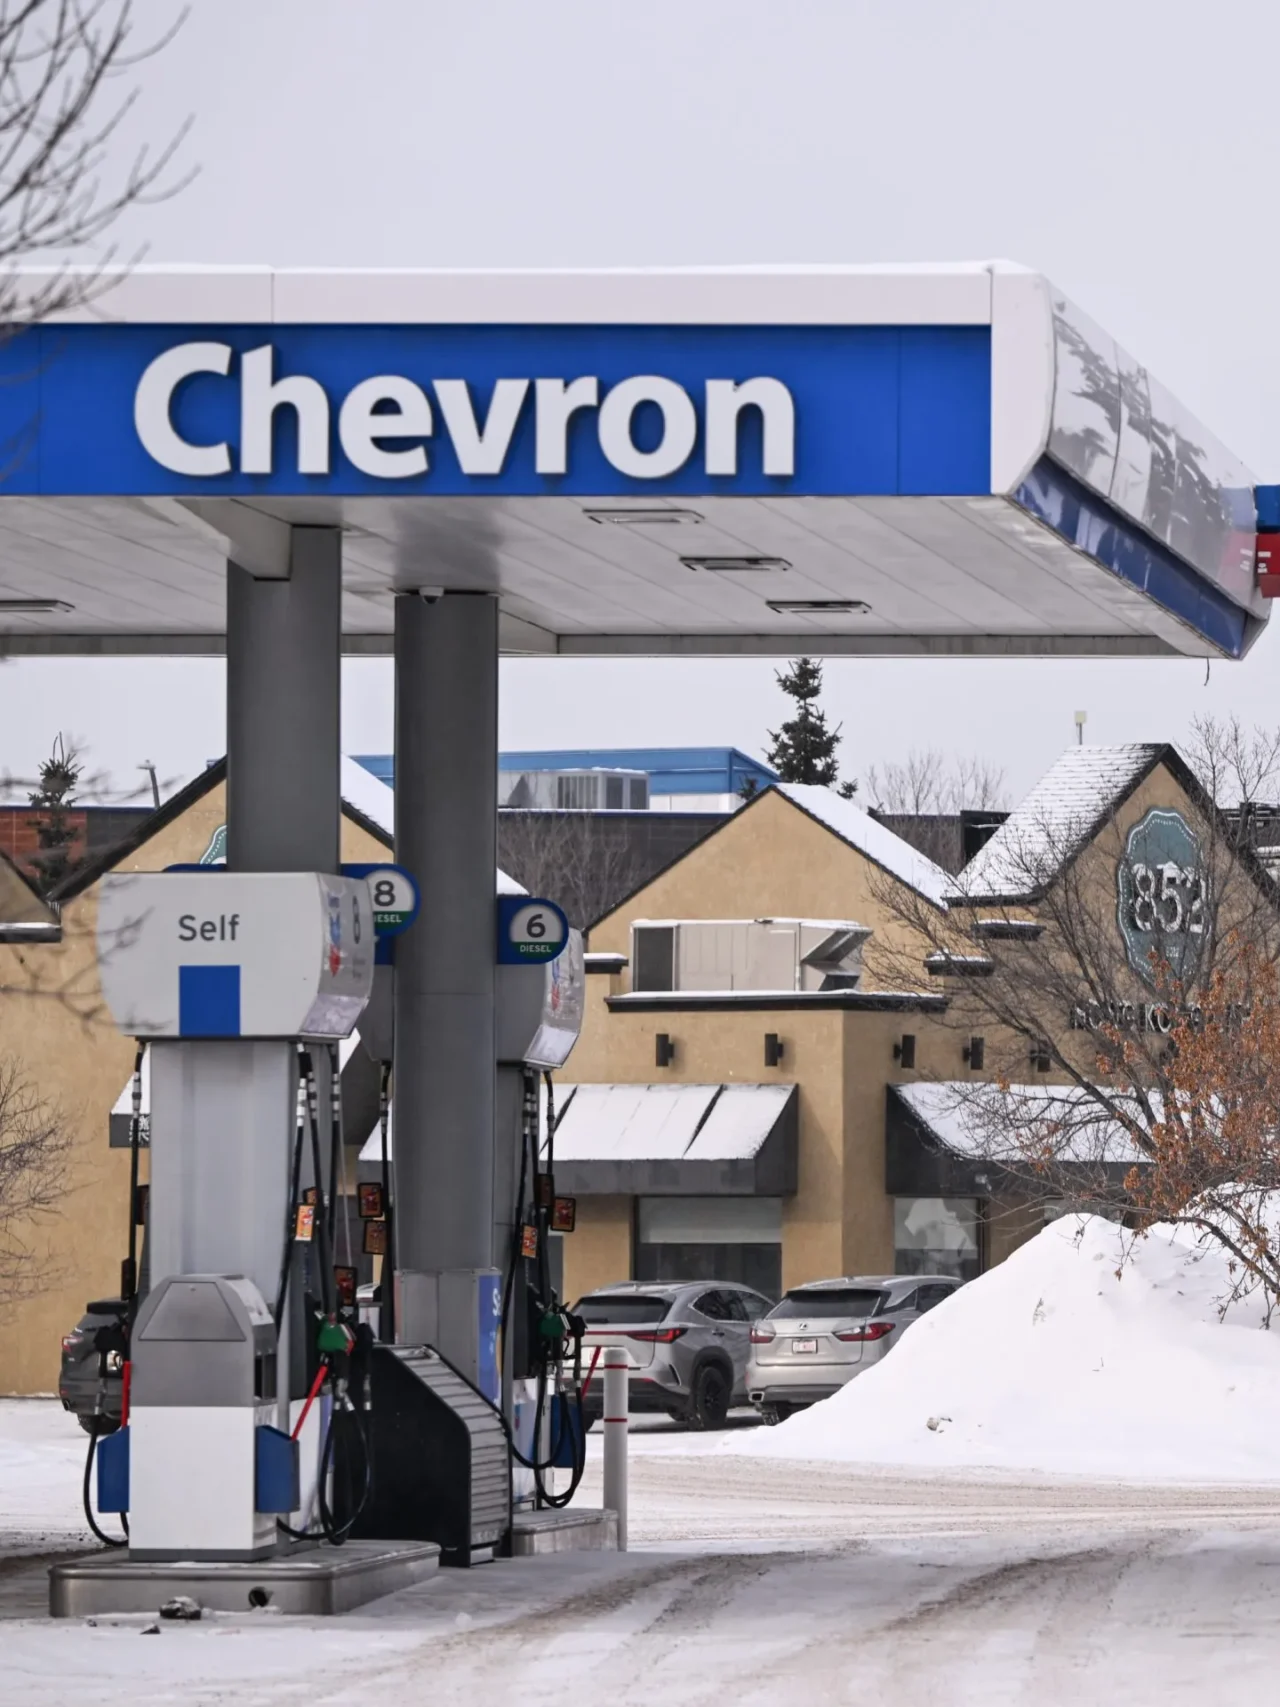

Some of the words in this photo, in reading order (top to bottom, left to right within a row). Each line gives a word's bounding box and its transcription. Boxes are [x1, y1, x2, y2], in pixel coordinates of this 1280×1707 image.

[133, 341, 795, 478] Chevron
[374, 880, 396, 907] 8
[1131, 861, 1207, 933] 852
[178, 913, 240, 941] Self
[526, 913, 546, 938] 6
[520, 944, 551, 953] DIESEL
